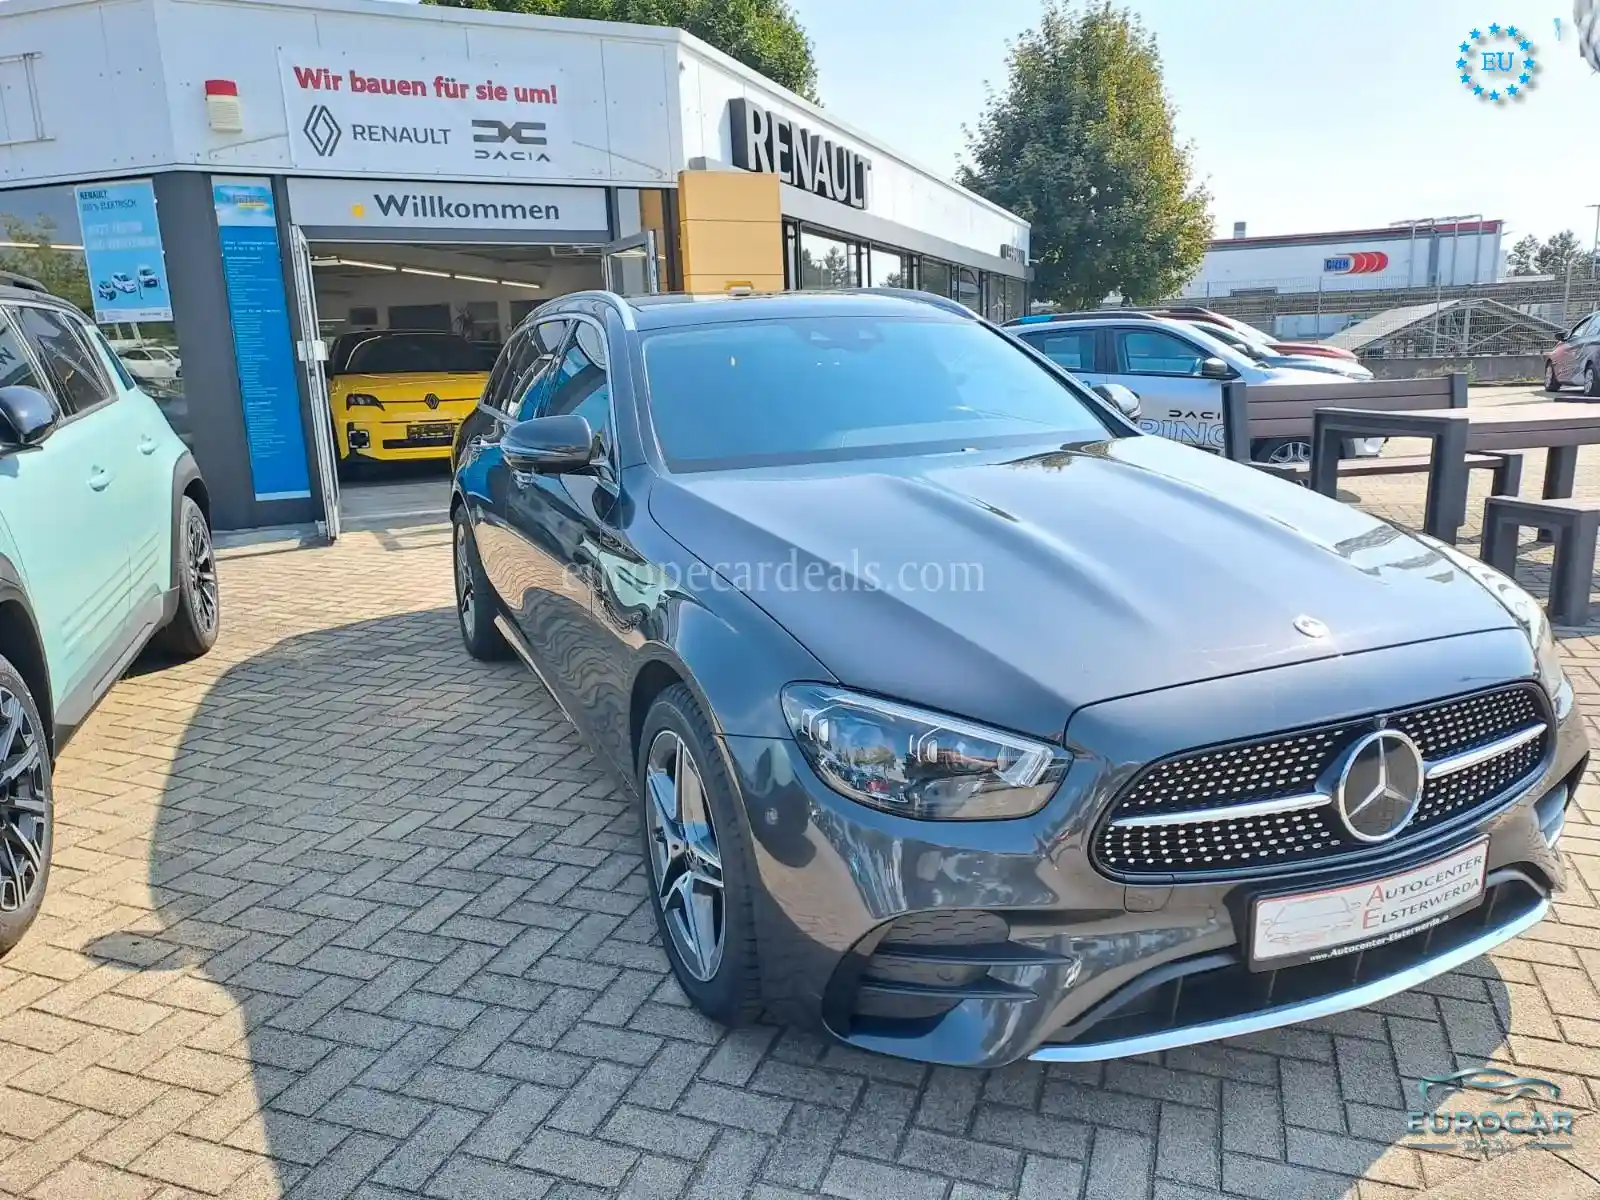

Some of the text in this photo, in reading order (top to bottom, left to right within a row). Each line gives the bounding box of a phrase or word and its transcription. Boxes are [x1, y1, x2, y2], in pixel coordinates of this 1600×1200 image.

[293, 66, 559, 105] Wir bauen für sie um!
[351, 123, 452, 146] RENAULT
[474, 149, 552, 162] DACIA
[737, 98, 872, 209] RENAULT
[80, 189, 108, 200] RENAULT
[373, 193, 560, 221] Willkommen
[1168, 409, 1221, 420] DACI
[1366, 855, 1483, 907] AUTOCENTER
[1362, 877, 1480, 930] ELSTERWERDA
